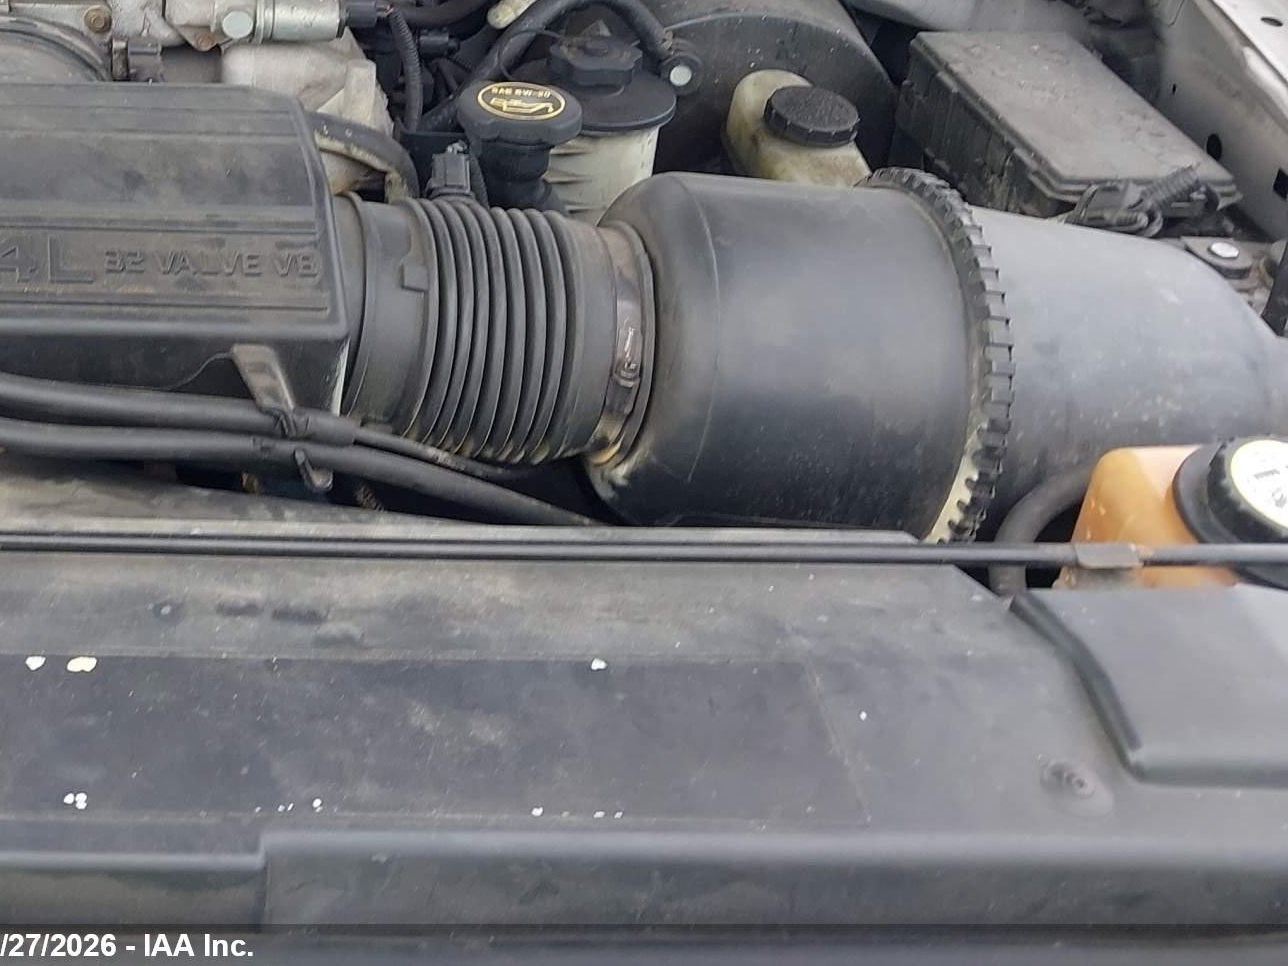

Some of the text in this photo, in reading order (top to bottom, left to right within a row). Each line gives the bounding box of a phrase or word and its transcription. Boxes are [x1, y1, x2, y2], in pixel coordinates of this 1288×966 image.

[104, 250, 145, 274] 32
[154, 250, 263, 277] VALVE
[272, 250, 322, 278] V8
